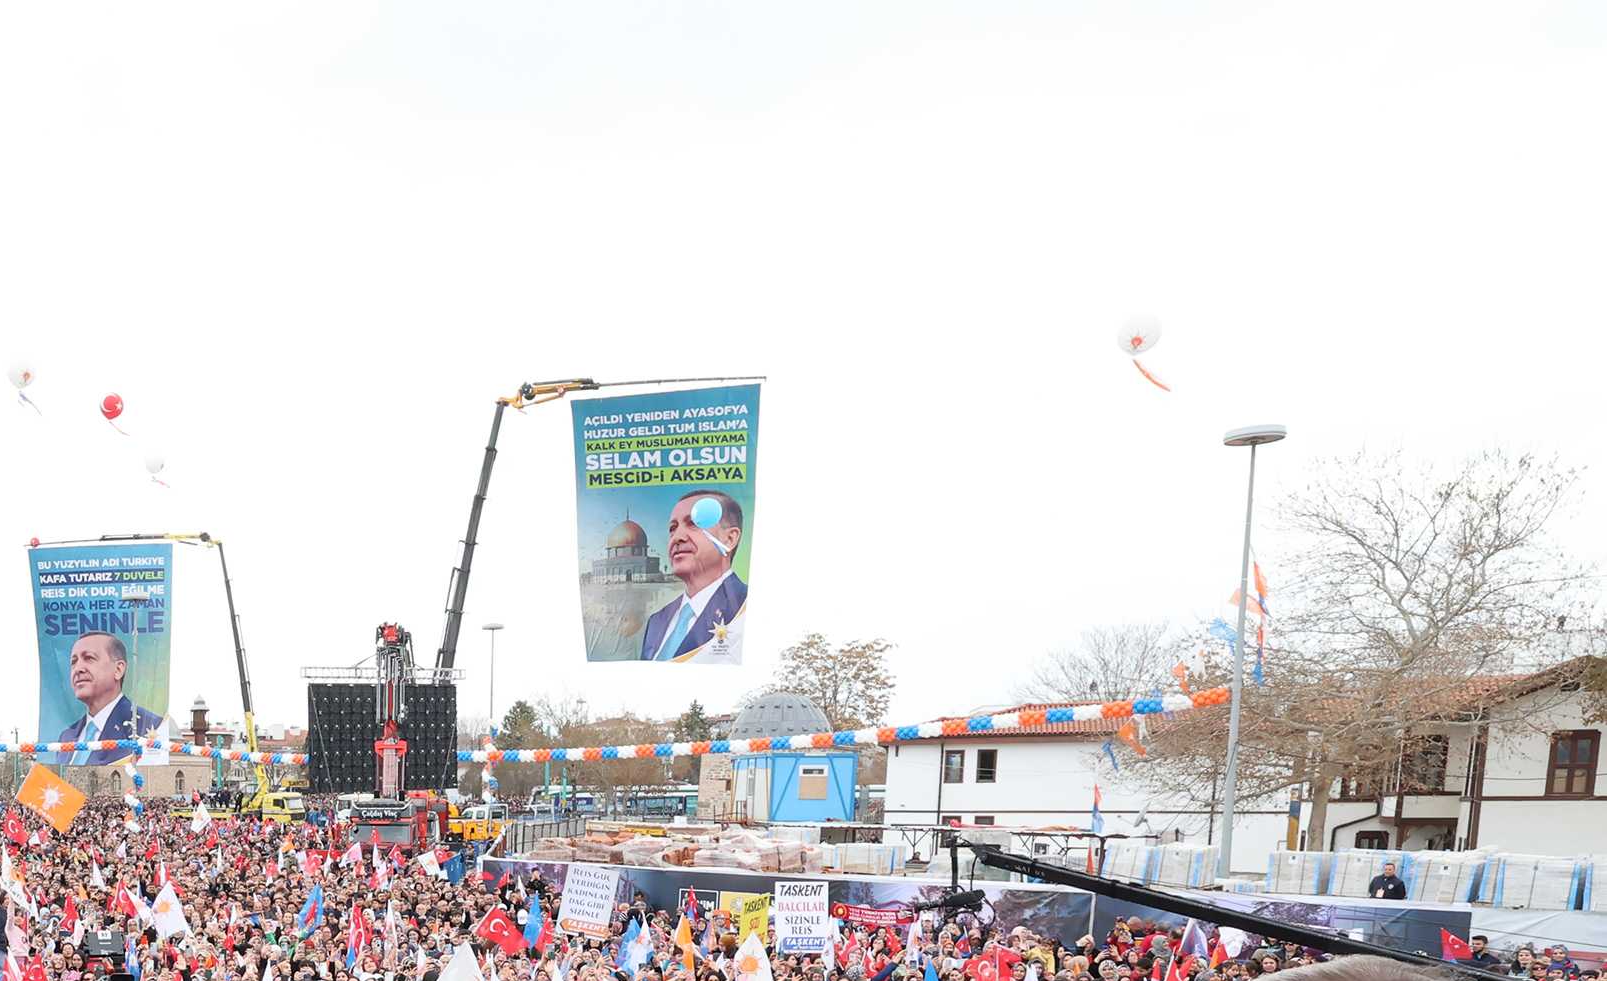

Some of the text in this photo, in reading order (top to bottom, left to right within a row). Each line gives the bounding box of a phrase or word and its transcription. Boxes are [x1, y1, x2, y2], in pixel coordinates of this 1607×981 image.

[683, 404, 748, 419] AYASOFYA
[583, 428, 625, 439] HUZUR
[586, 440, 615, 451] KALK
[619, 439, 633, 449] EY
[703, 433, 745, 445] KIYAMA
[586, 445, 746, 471] SELAM OLSUN
[671, 466, 744, 482] AKSA'YA
[37, 561, 51, 570] BU
[40, 574, 67, 583] KAFA
[69, 572, 113, 583] TUTARIZ
[114, 572, 120, 581] 7
[44, 598, 164, 611] KONYA HER ZAMAN
